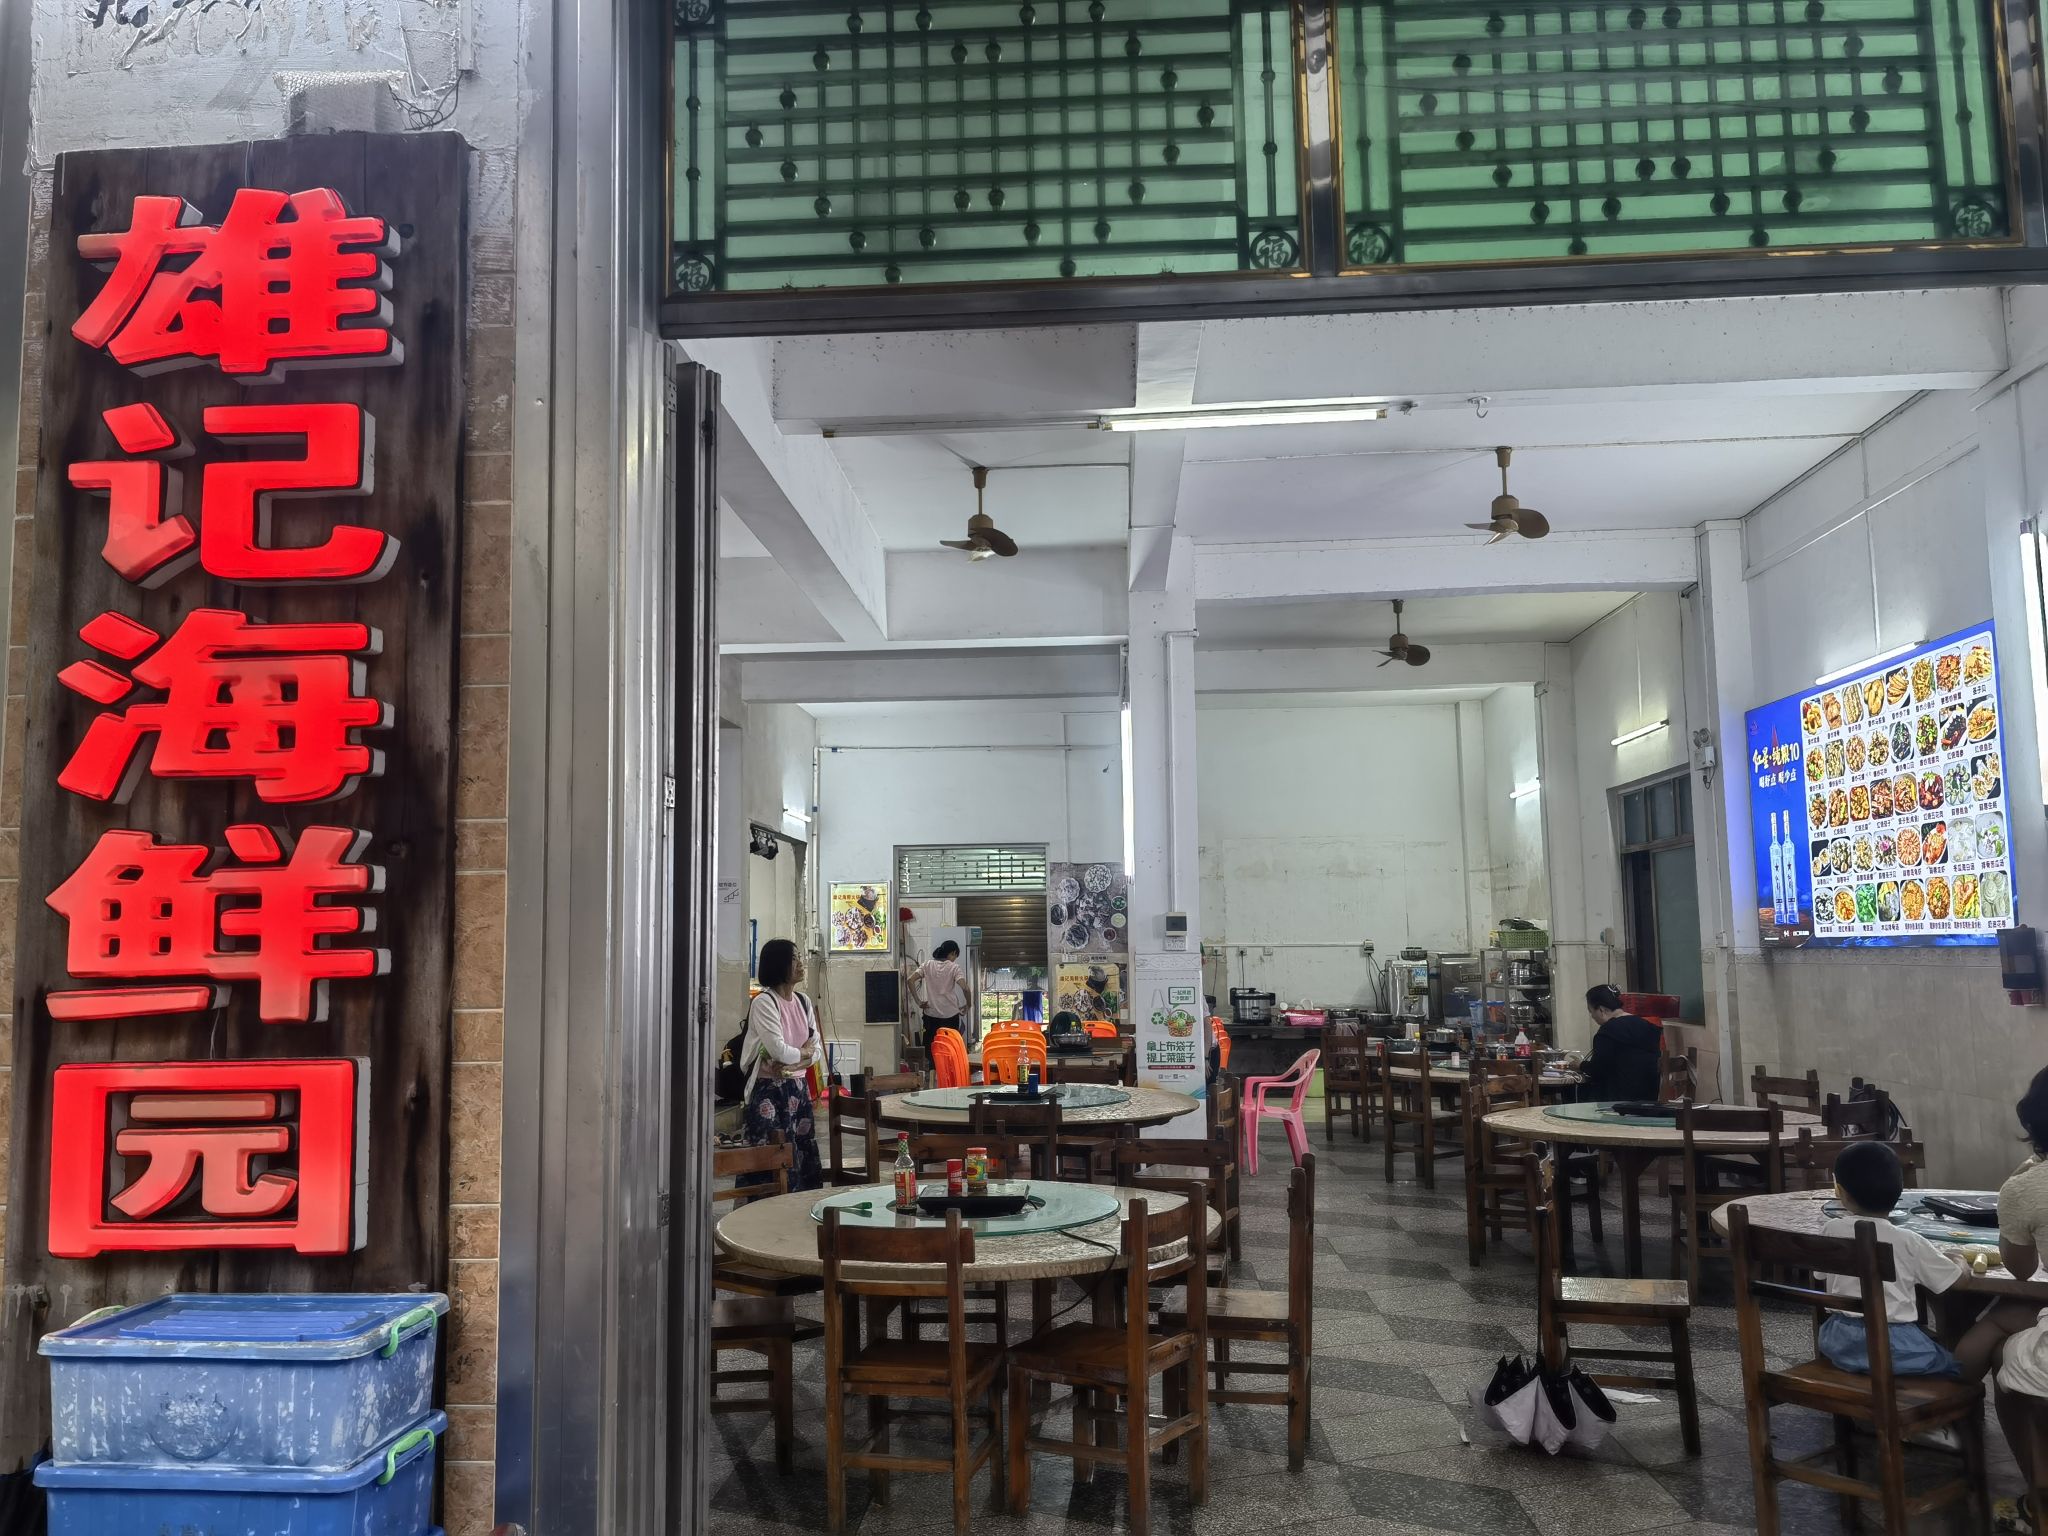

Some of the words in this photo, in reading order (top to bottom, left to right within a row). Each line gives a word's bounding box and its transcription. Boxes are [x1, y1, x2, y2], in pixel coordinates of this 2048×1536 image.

[1256, 236, 1290, 268] 福
[46, 186, 402, 1258] 雄记海鲜园
